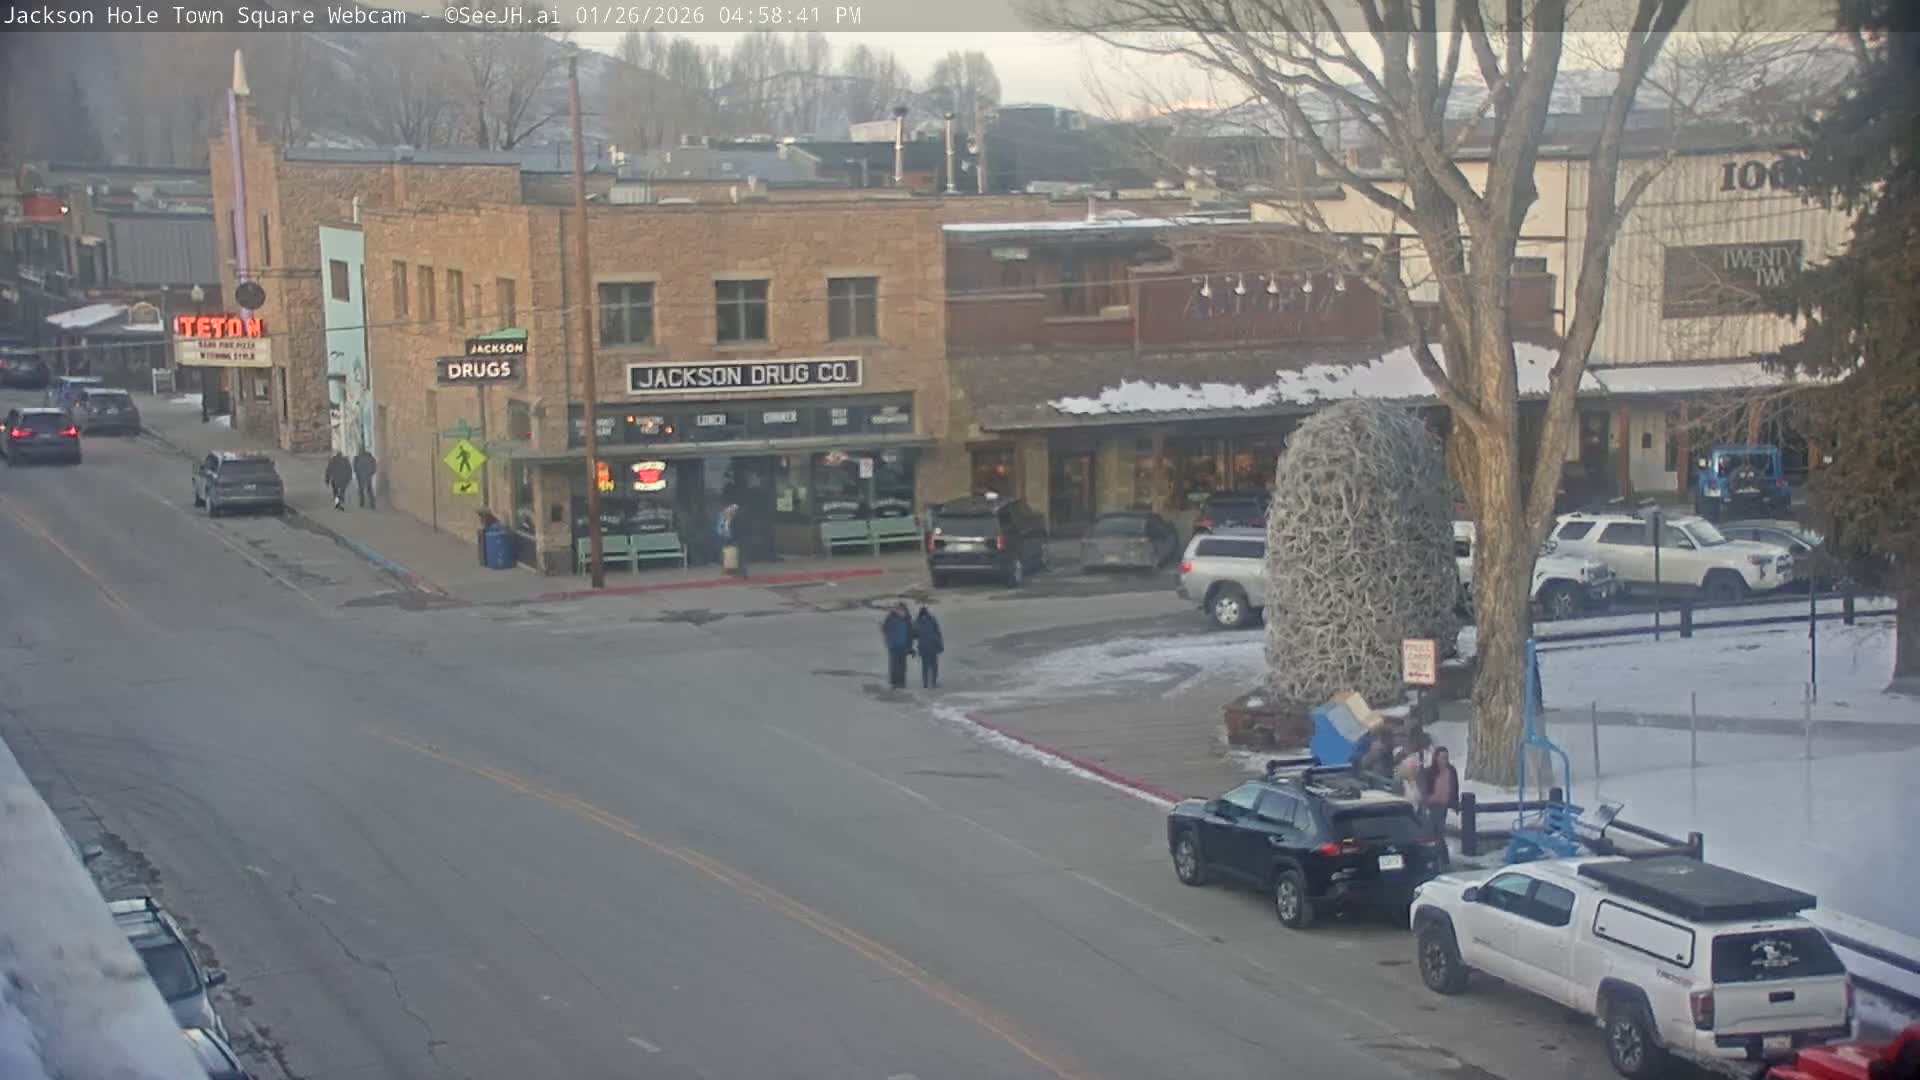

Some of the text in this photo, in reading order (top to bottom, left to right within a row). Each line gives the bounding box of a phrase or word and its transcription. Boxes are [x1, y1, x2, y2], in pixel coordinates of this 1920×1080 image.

[1722, 247, 1798, 269] TWENTY
[1756, 267, 1786, 287] TW
[180, 315, 263, 338] TETON
[470, 343, 524, 354] JACKSON
[448, 361, 511, 379] DRUGS
[639, 362, 849, 388] JACKSON DRUG CO.
